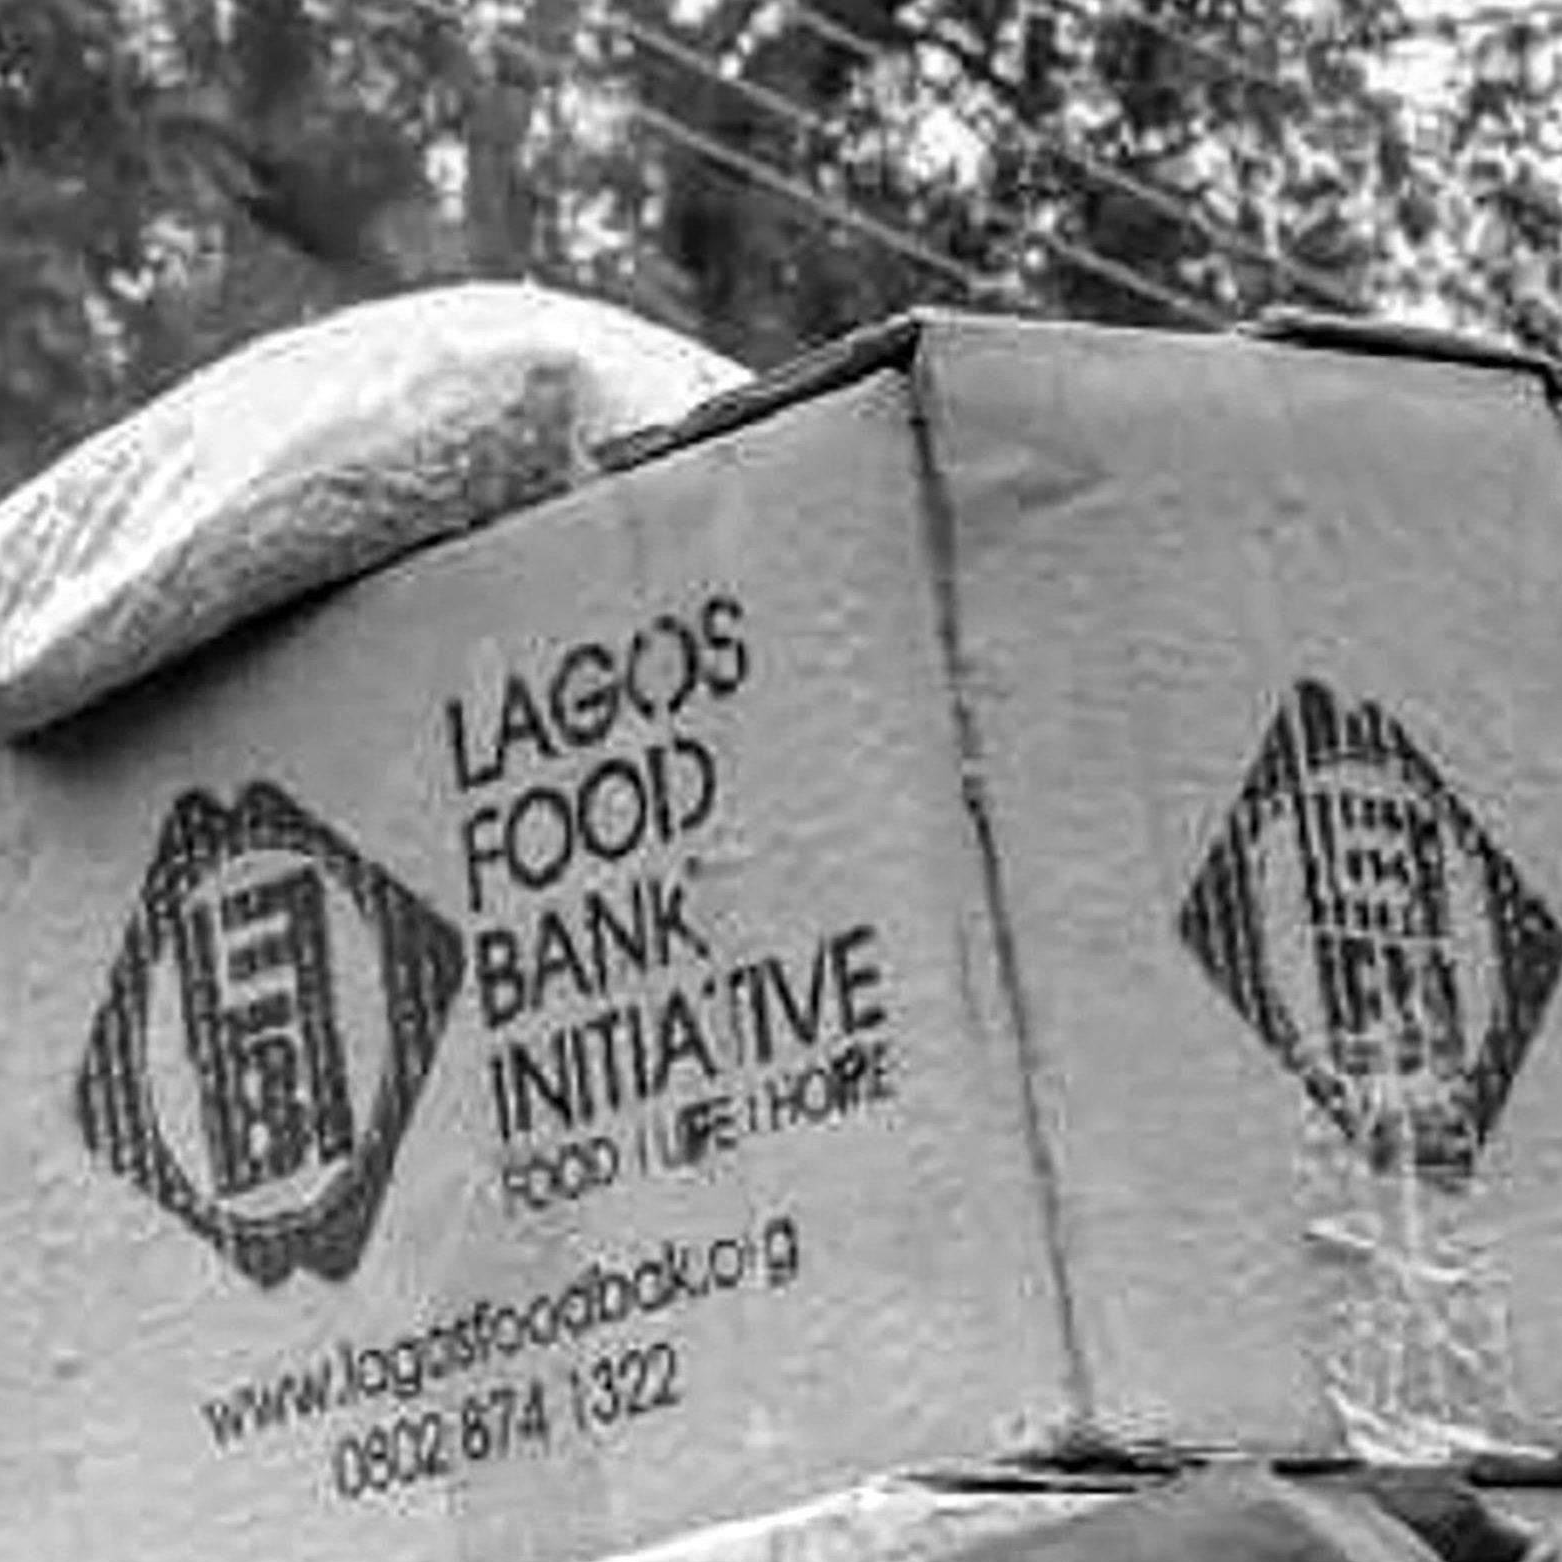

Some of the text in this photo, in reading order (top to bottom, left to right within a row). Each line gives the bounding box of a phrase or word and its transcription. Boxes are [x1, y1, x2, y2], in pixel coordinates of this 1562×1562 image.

[447, 597, 749, 790] LAGOS
[462, 737, 716, 912] FOOD
[476, 876, 711, 1029] BANK
[490, 924, 887, 1141] INITIATIVE
